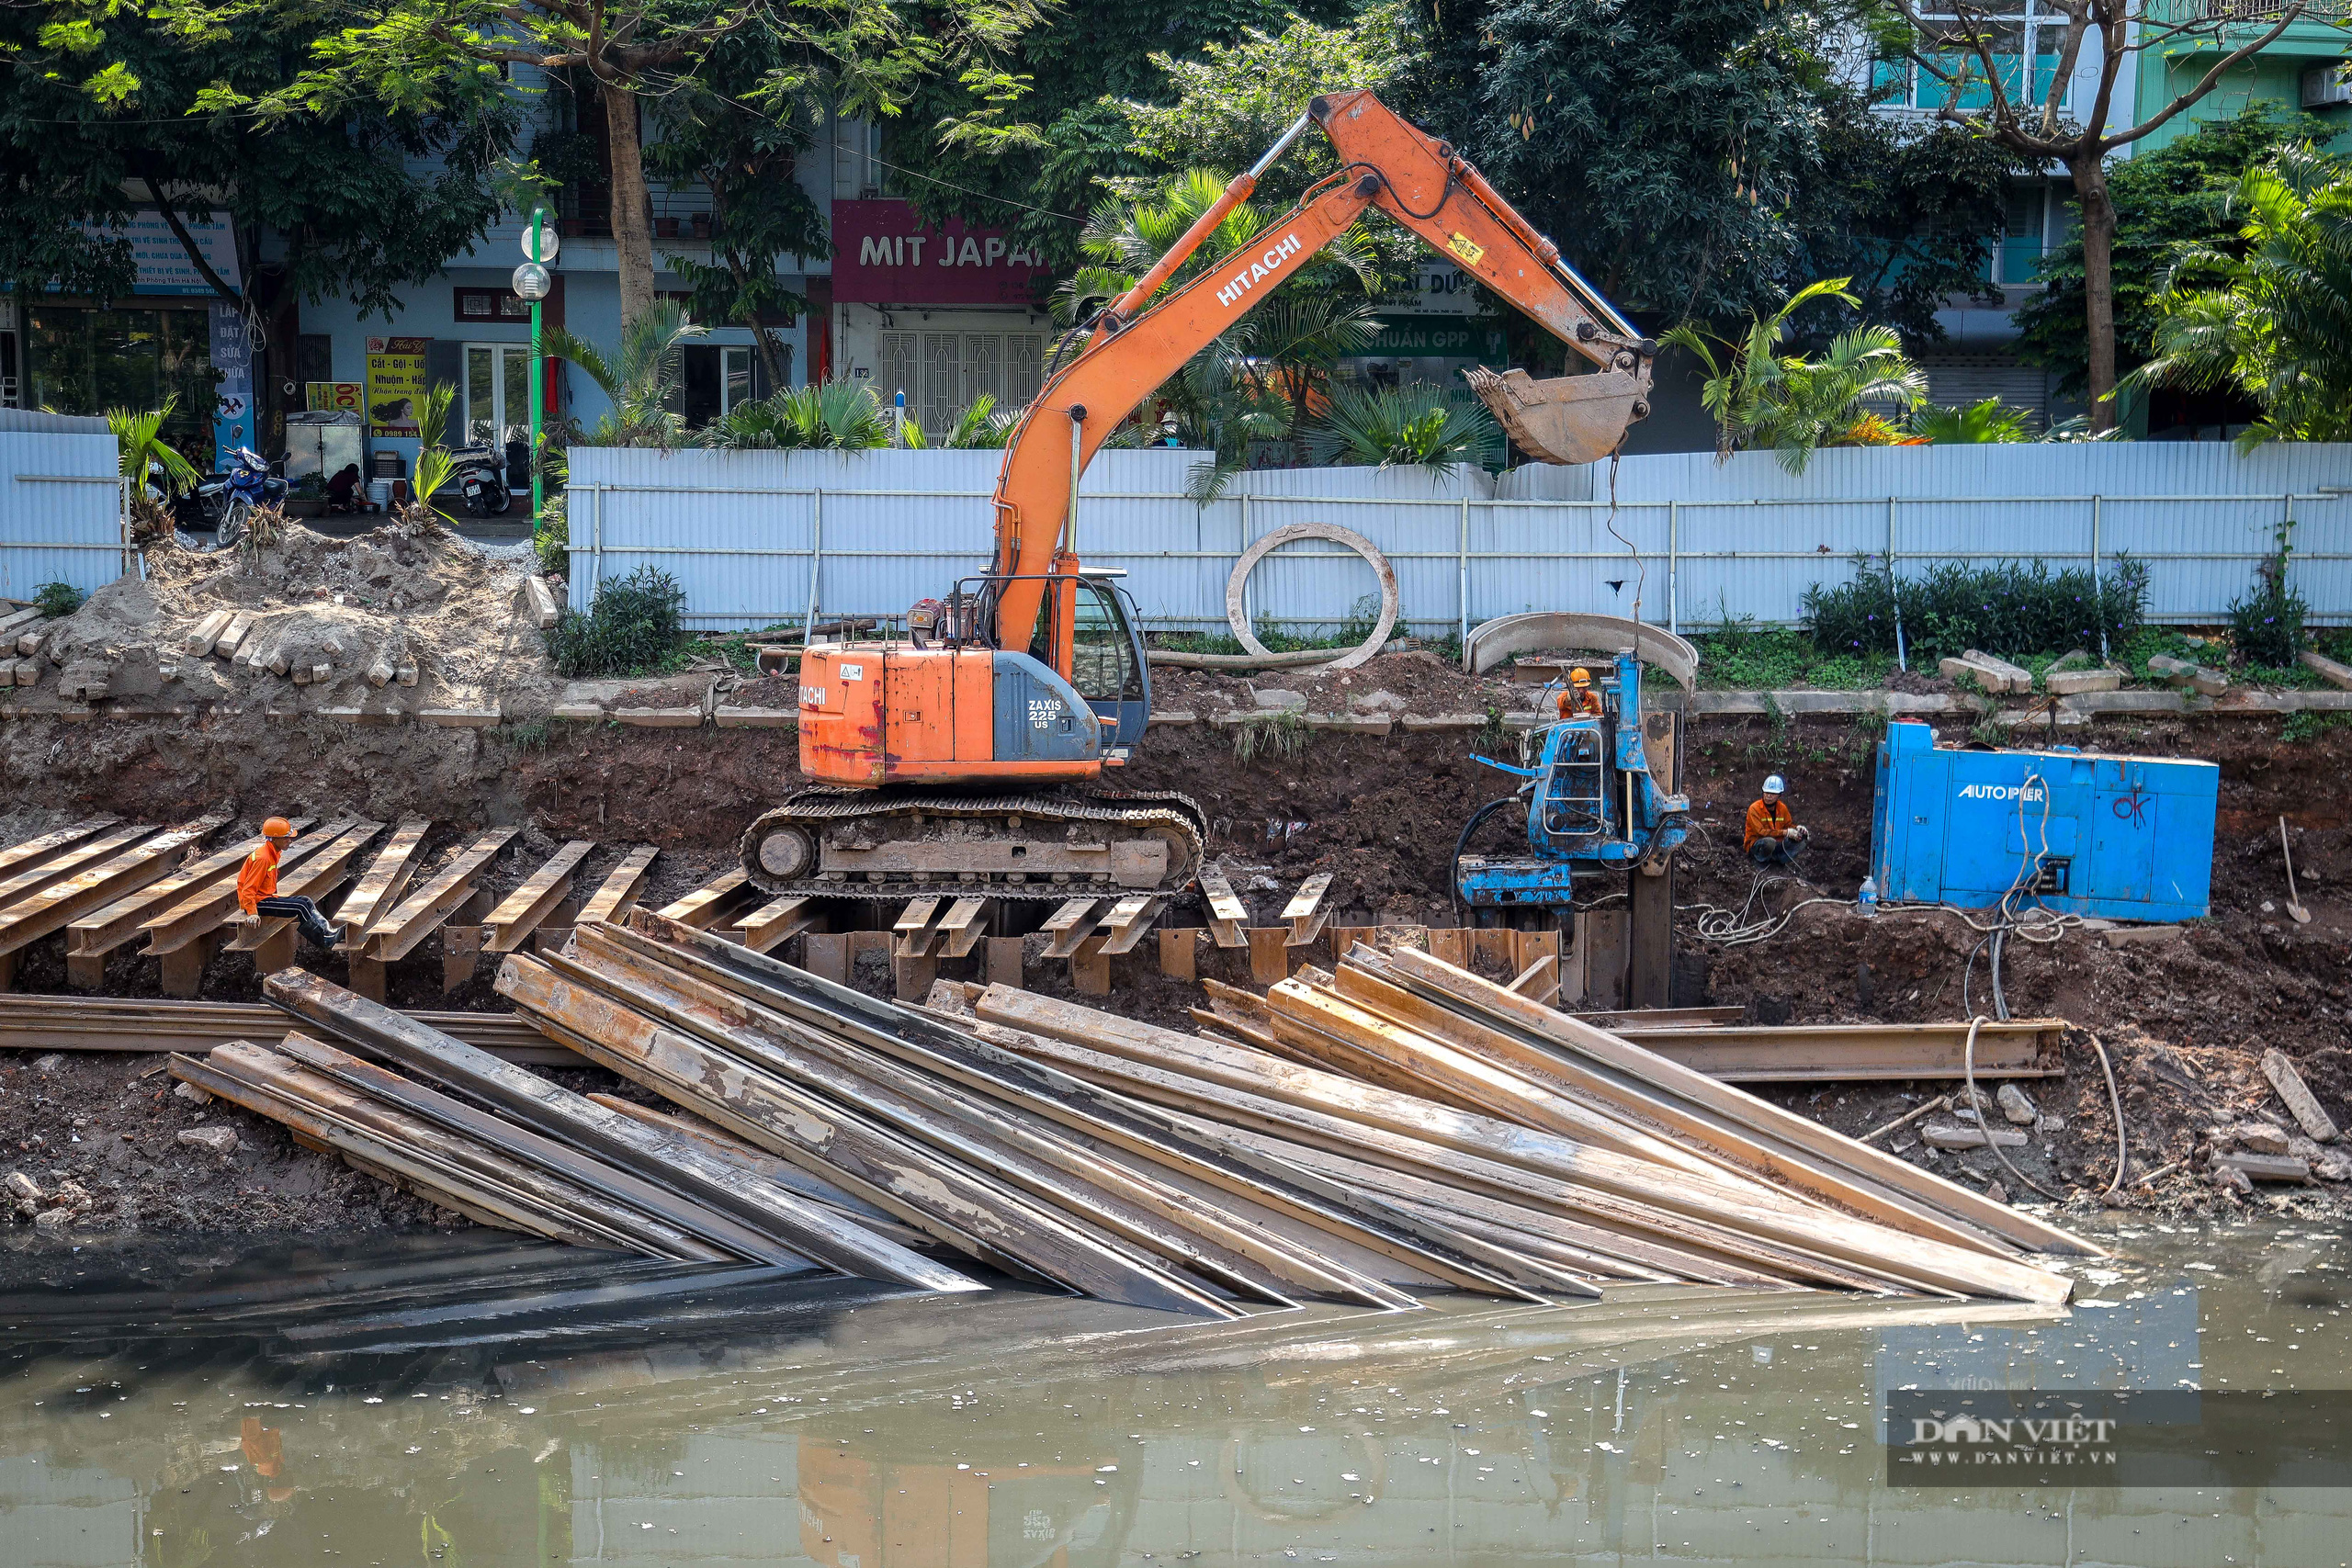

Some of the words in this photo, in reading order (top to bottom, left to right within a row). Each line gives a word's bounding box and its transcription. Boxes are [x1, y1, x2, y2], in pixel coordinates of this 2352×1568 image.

[859, 235, 926, 266] MIT
[1216, 232, 1302, 308] HITACHI
[1431, 331, 1469, 348] GPP
[371, 356, 385, 368] Cắt
[392, 358, 406, 371] Gội
[375, 374, 404, 387] Nhuộm
[1028, 699, 1062, 711] ZAXIS
[1028, 711, 1057, 721] 225
[2112, 796, 2151, 829] OK
